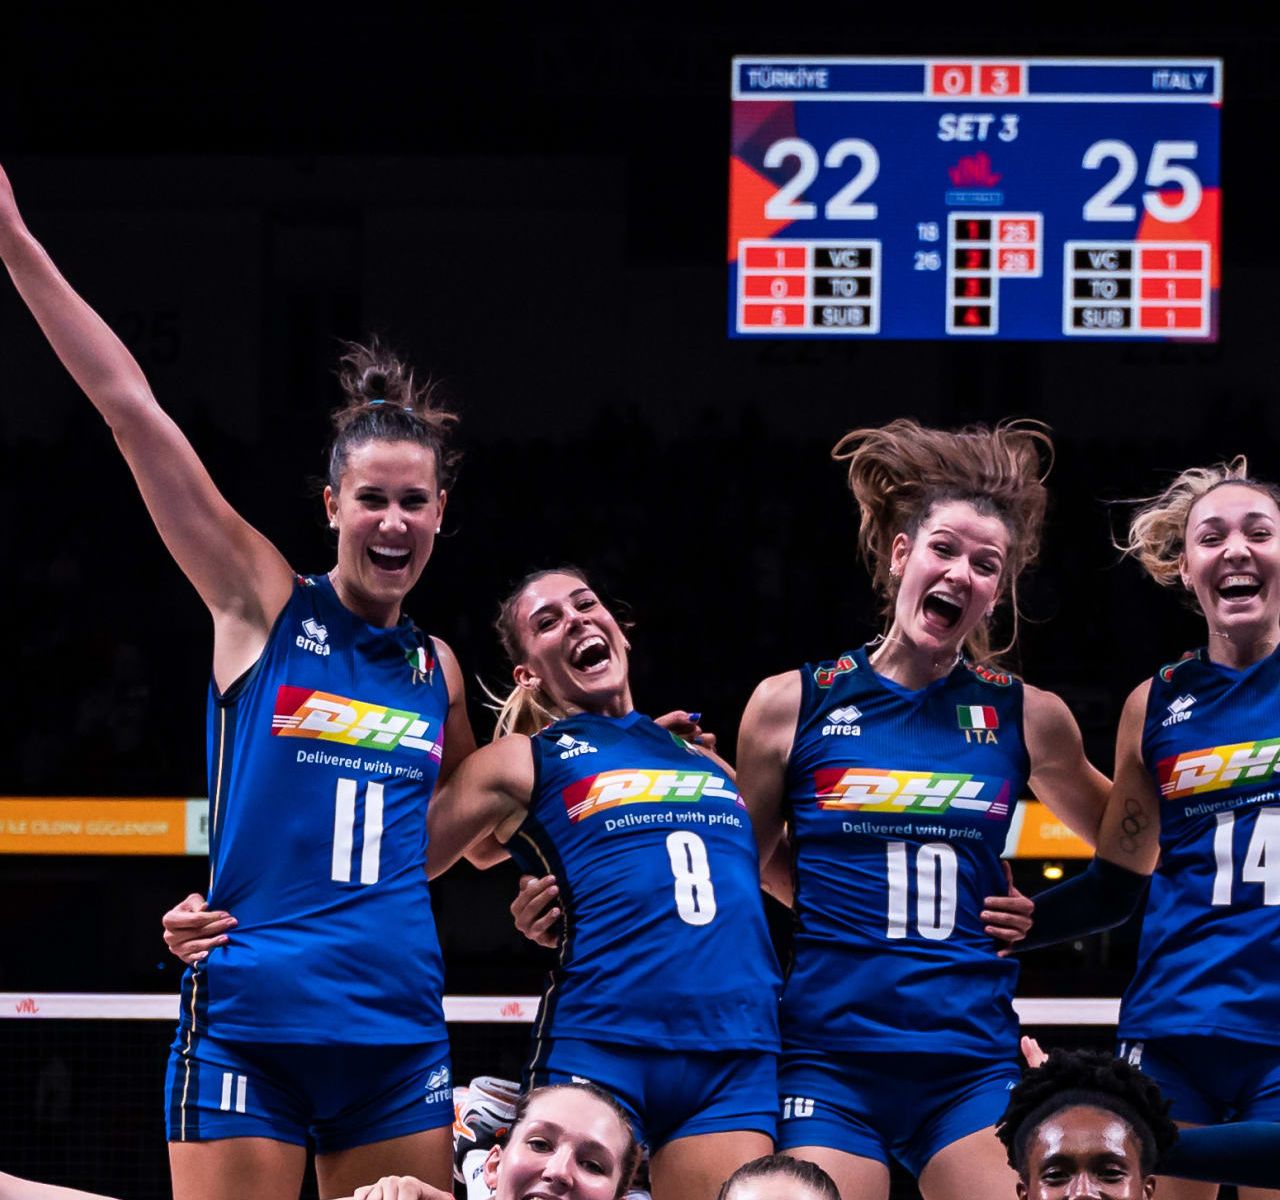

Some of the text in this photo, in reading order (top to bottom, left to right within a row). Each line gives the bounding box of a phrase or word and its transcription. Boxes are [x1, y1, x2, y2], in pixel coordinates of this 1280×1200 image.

[943, 68, 1010, 95] 0 3
[1152, 72, 1209, 90] ITALY
[937, 113, 1020, 142] SET 3
[762, 137, 881, 221] 22
[1081, 140, 1203, 223] 25
[775, 249, 860, 269] 1 VC
[1087, 250, 1177, 270] VC 1
[770, 277, 859, 298] 0 TO
[1088, 280, 1177, 299] TO 1
[822, 307, 865, 326] SUB
[1081, 308, 1177, 328] SUB 1
[295, 634, 331, 657] errea
[299, 697, 434, 752] DHL
[822, 723, 861, 737] errea
[965, 728, 999, 745] ITA
[296, 749, 425, 782] Delivered with pride.
[592, 772, 739, 806] DHL
[837, 773, 993, 812] DHL
[1183, 795, 1244, 818] Delivered
[1246, 790, 1275, 804] with
[331, 777, 385, 886] 11
[604, 811, 744, 833] Delivered with pride.
[841, 821, 985, 841] Delivered with pride.
[665, 830, 717, 926] 8
[886, 841, 959, 942] 10
[220, 1072, 248, 1114] 11
